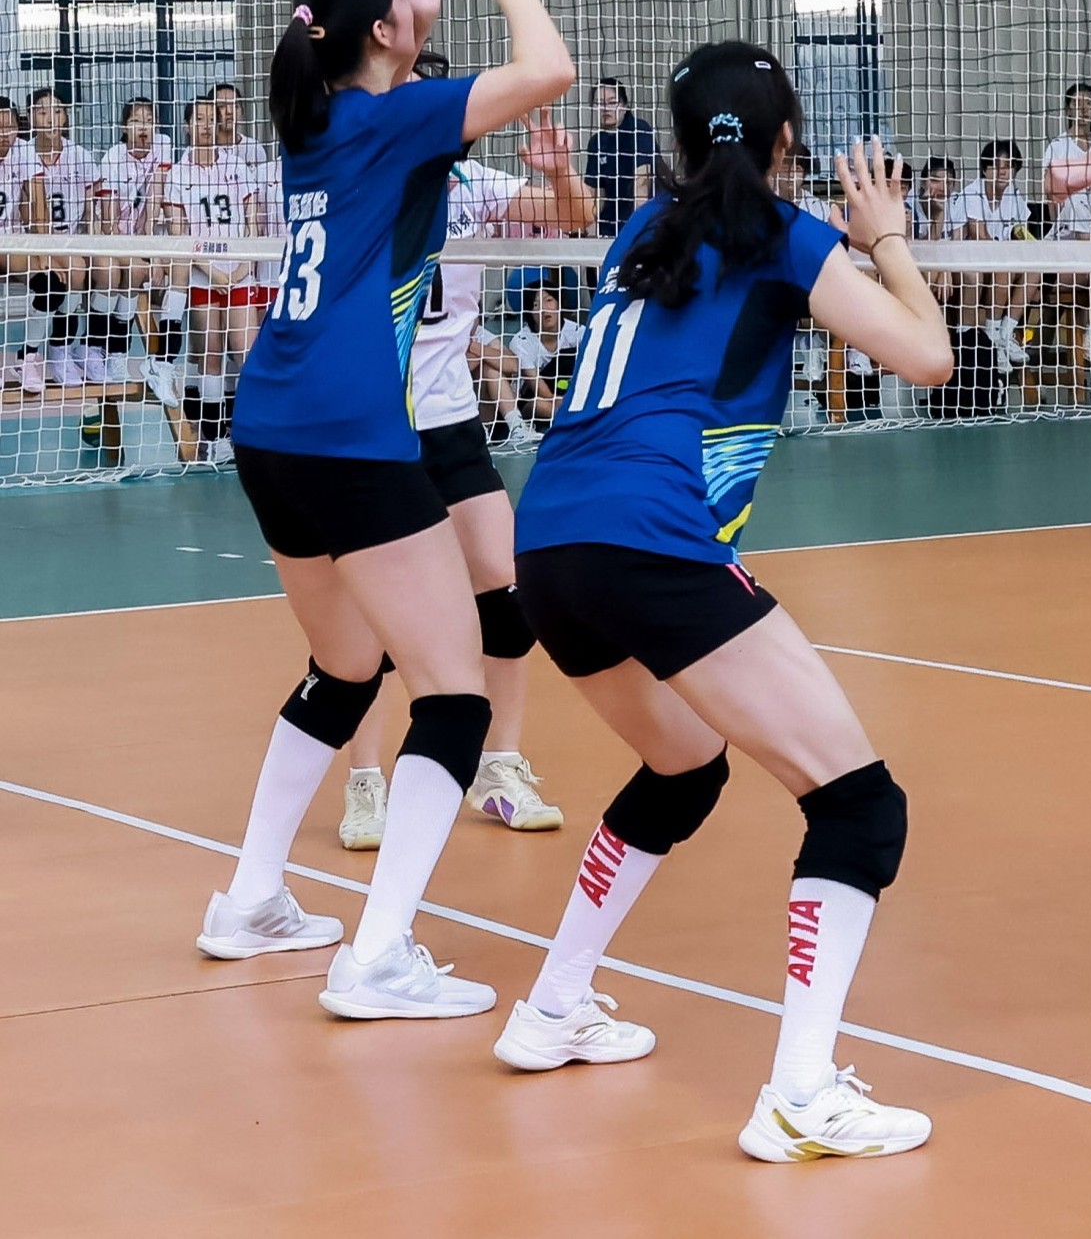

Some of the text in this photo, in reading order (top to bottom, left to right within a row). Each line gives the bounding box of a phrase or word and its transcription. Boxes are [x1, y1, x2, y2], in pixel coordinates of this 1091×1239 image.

[200, 194, 232, 228] 13
[271, 220, 327, 322] 13
[568, 298, 645, 412] 11
[578, 824, 627, 909] ANTA
[788, 900, 822, 989] ANTA
